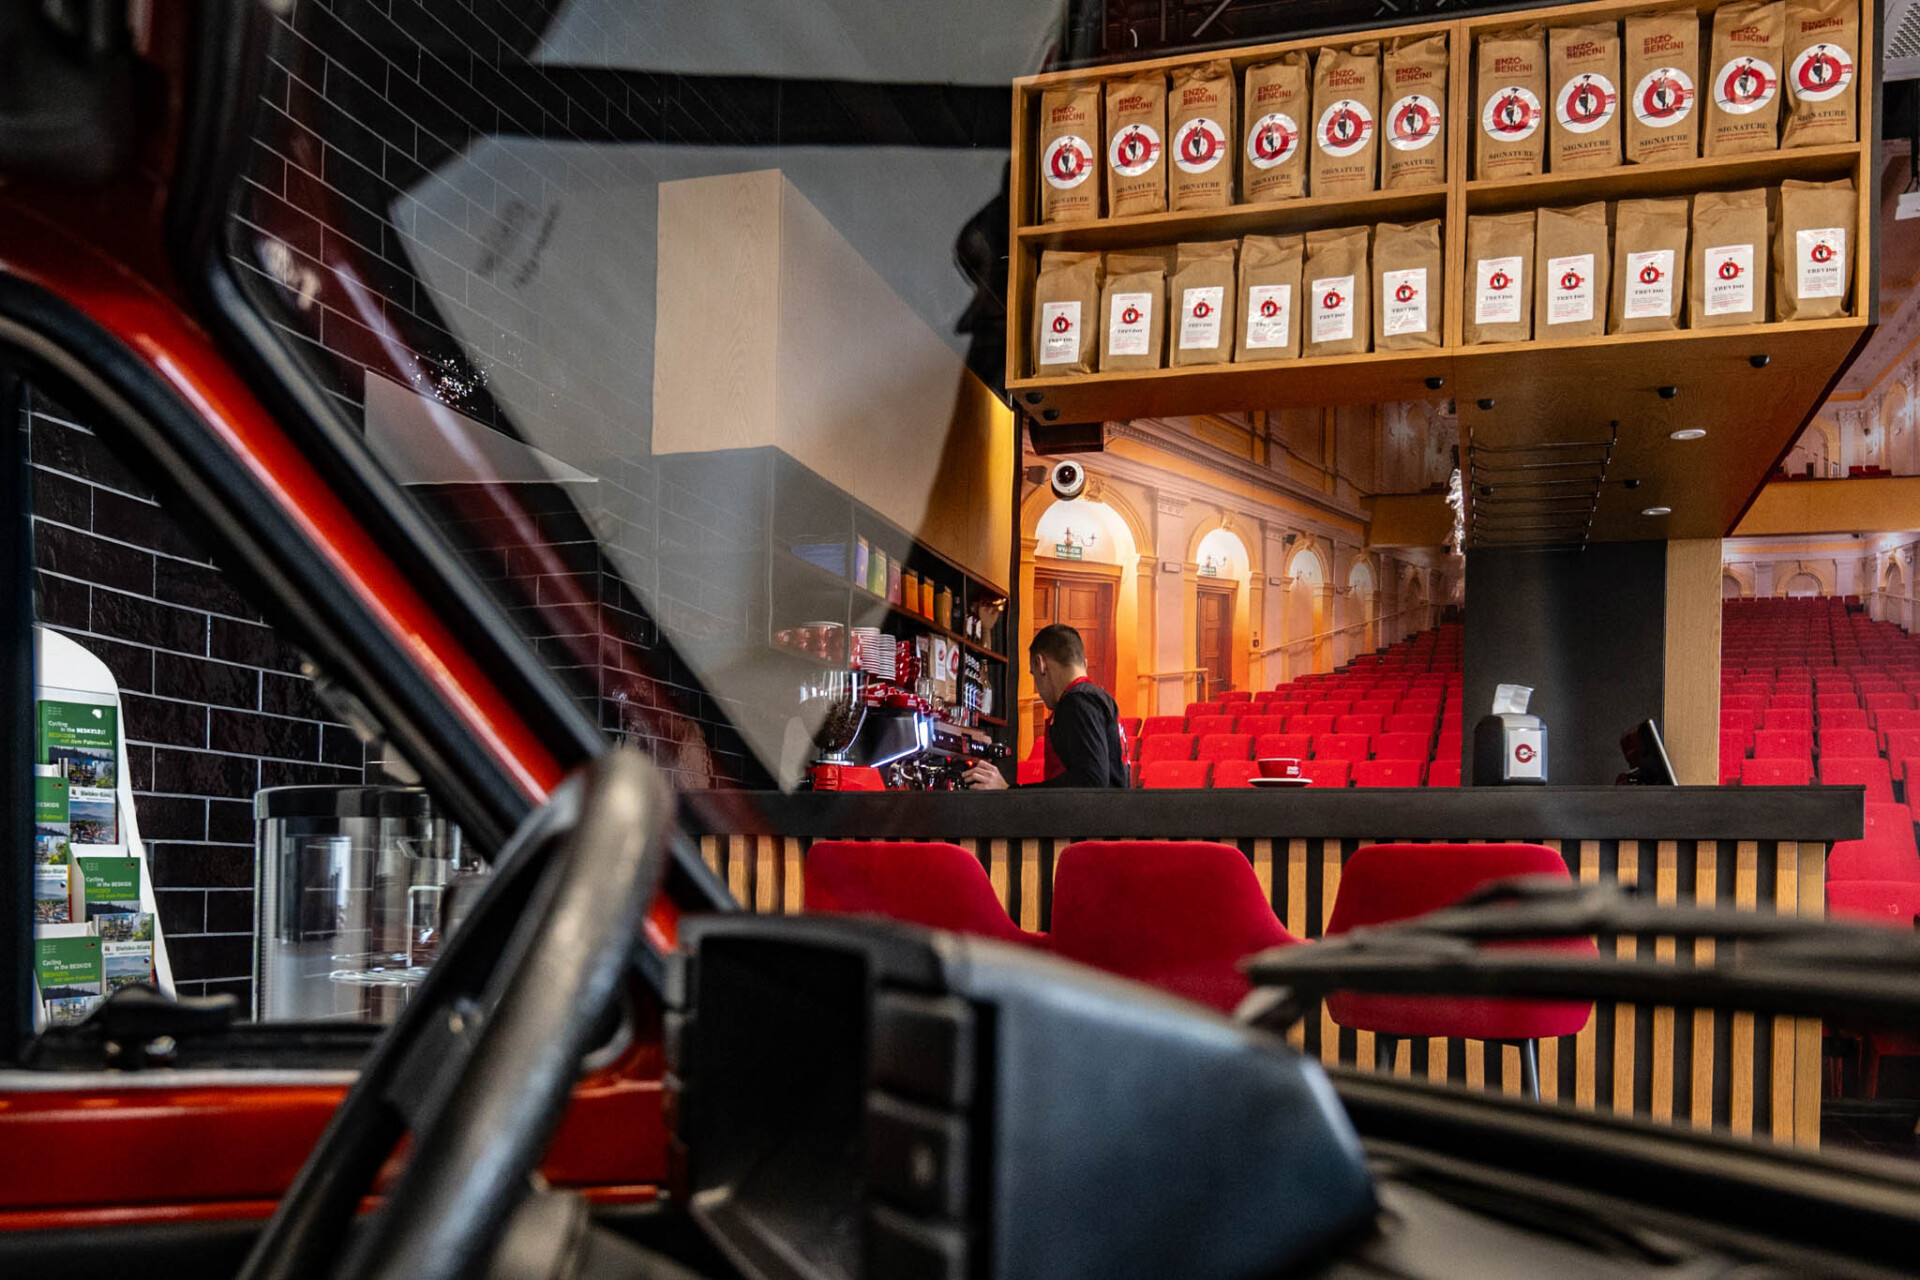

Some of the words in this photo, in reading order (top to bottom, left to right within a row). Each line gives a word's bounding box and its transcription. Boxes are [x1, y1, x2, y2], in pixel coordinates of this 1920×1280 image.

[1644, 34, 1673, 45] ENZO
[1731, 33, 1769, 43] BENCINI
[1567, 42, 1594, 52] ENZO
[1644, 41, 1684, 54] BENCINI
[1567, 46, 1605, 59] BENCINI
[1495, 57, 1522, 65] ENZO
[1396, 67, 1423, 75] ENZO
[1495, 64, 1532, 73] BENCINI
[1330, 69, 1355, 79] ENZO
[1396, 71, 1432, 83] BENCINI
[1329, 76, 1365, 87] BENCINI
[1183, 87, 1208, 97] ENZO
[1258, 84, 1282, 94] ENZO
[1183, 94, 1217, 105] BENCINI
[1257, 90, 1290, 102] BENCINI
[1118, 101, 1152, 112] BENCINI
[1052, 112, 1084, 123] BENCINI
[1717, 123, 1768, 133] SIGNATURE
[1562, 140, 1610, 152] SIGNATURE
[1639, 135, 1688, 147] SIGNATURE
[1488, 151, 1533, 159] SIGNATURE
[1321, 166, 1365, 175] SIGNATURE
